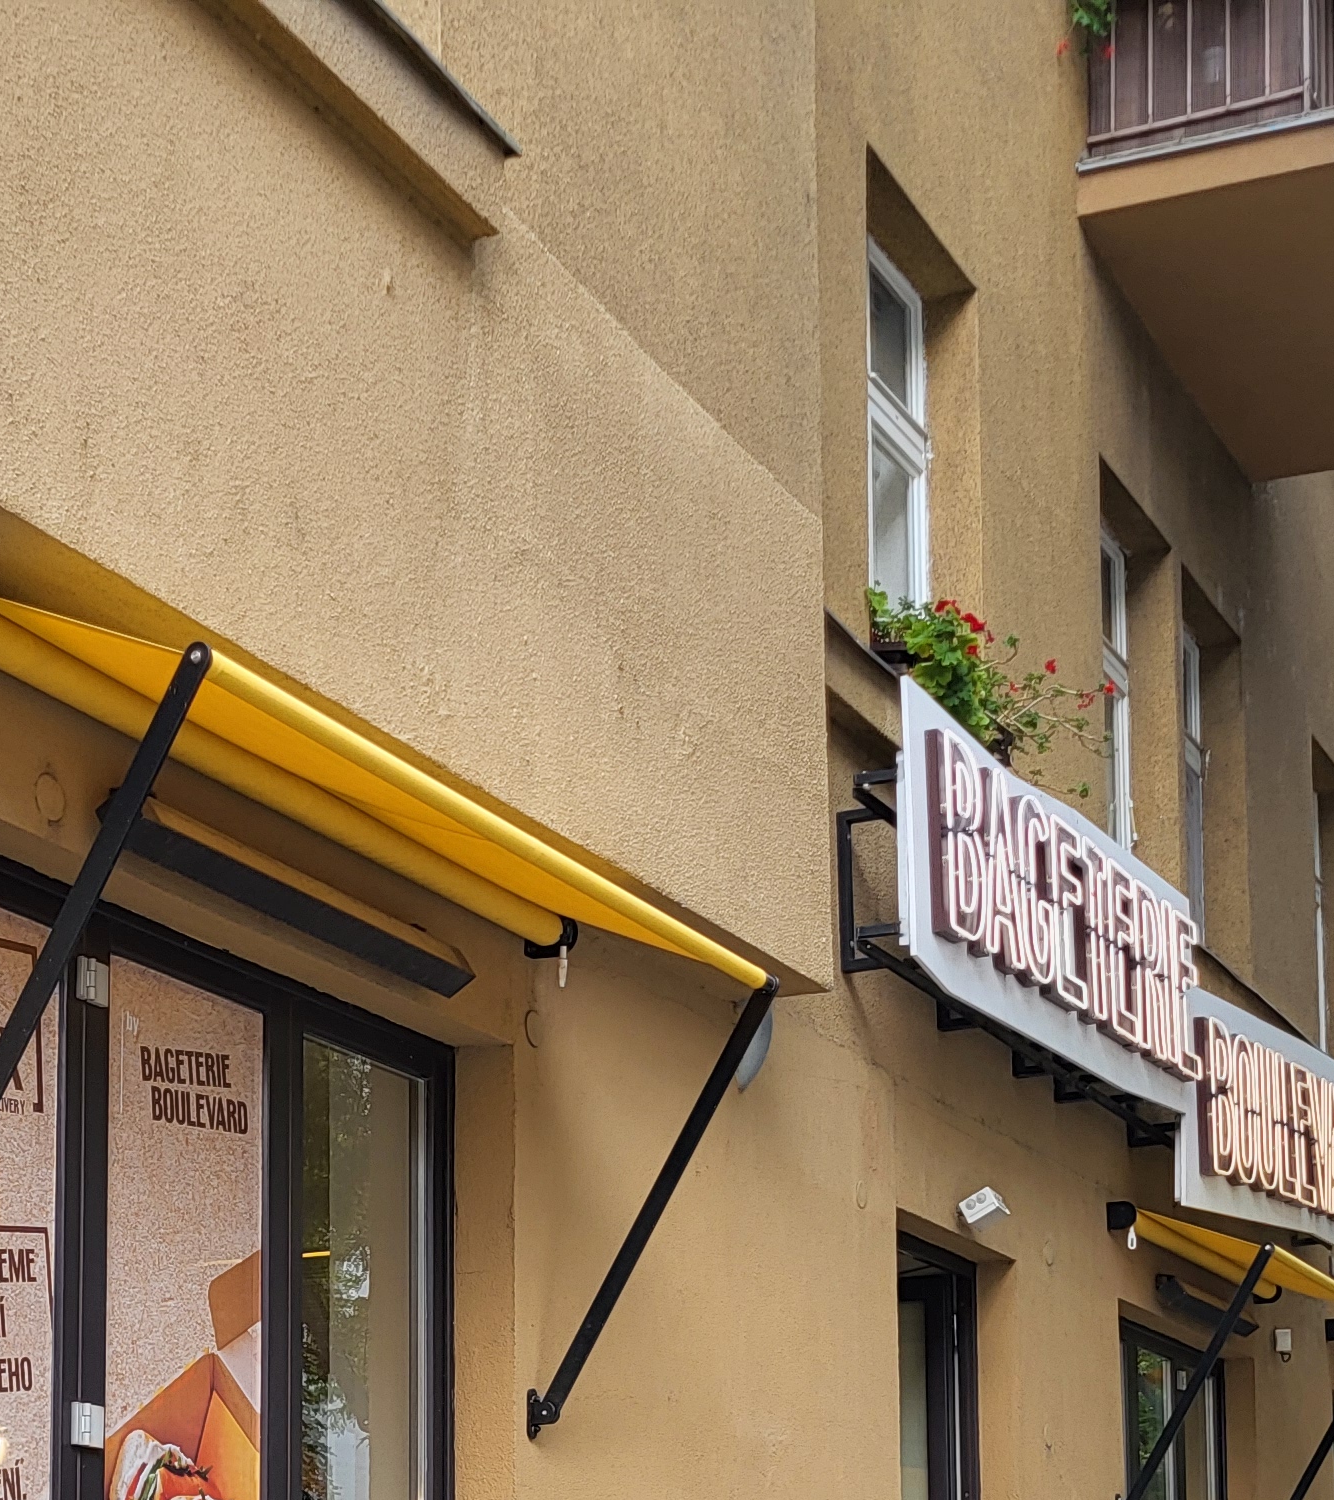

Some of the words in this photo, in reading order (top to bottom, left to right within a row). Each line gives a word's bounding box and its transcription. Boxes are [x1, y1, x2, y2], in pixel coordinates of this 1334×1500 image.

[927, 727, 1204, 1082] BAGETERIE
[126, 1010, 139, 1037] by
[139, 1045, 232, 1089] BAGETERIE
[151, 1085, 248, 1135] BOULEVARD
